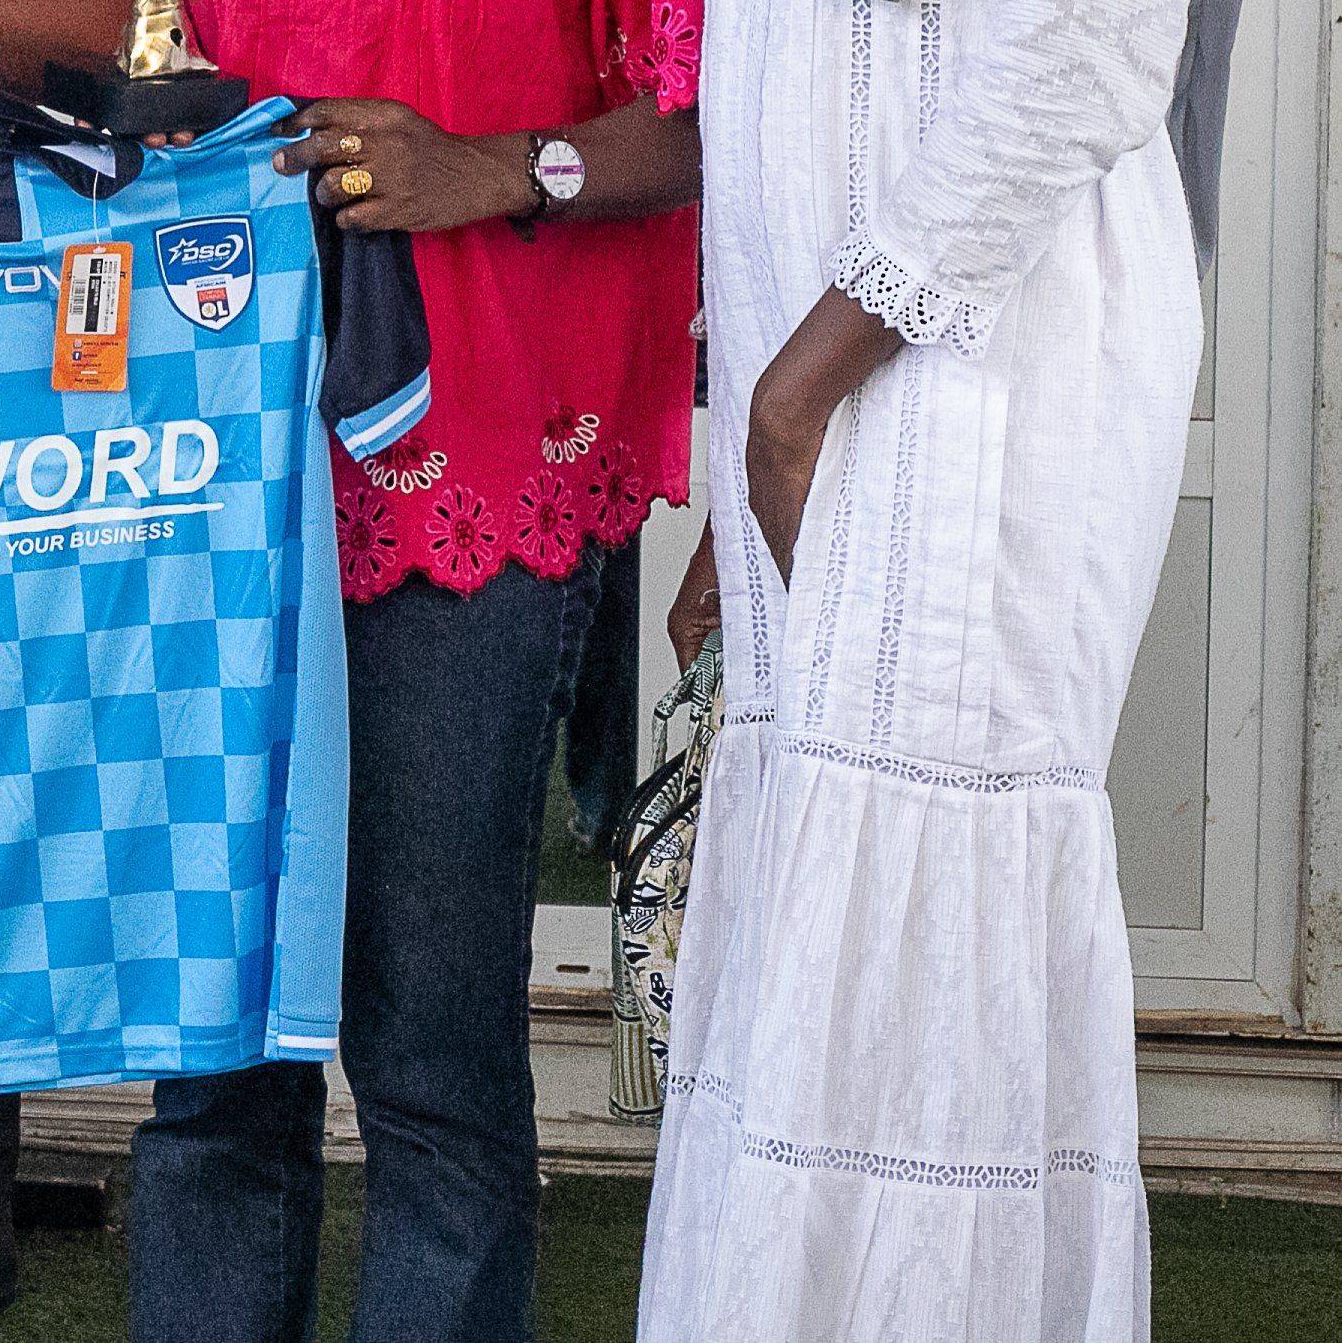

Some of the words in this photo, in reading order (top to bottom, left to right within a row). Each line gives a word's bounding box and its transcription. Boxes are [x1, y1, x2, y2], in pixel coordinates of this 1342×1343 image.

[181, 242, 232, 262] DSC
[5, 534, 65, 558] YOUR
[70, 521, 175, 549] BUSINESS
